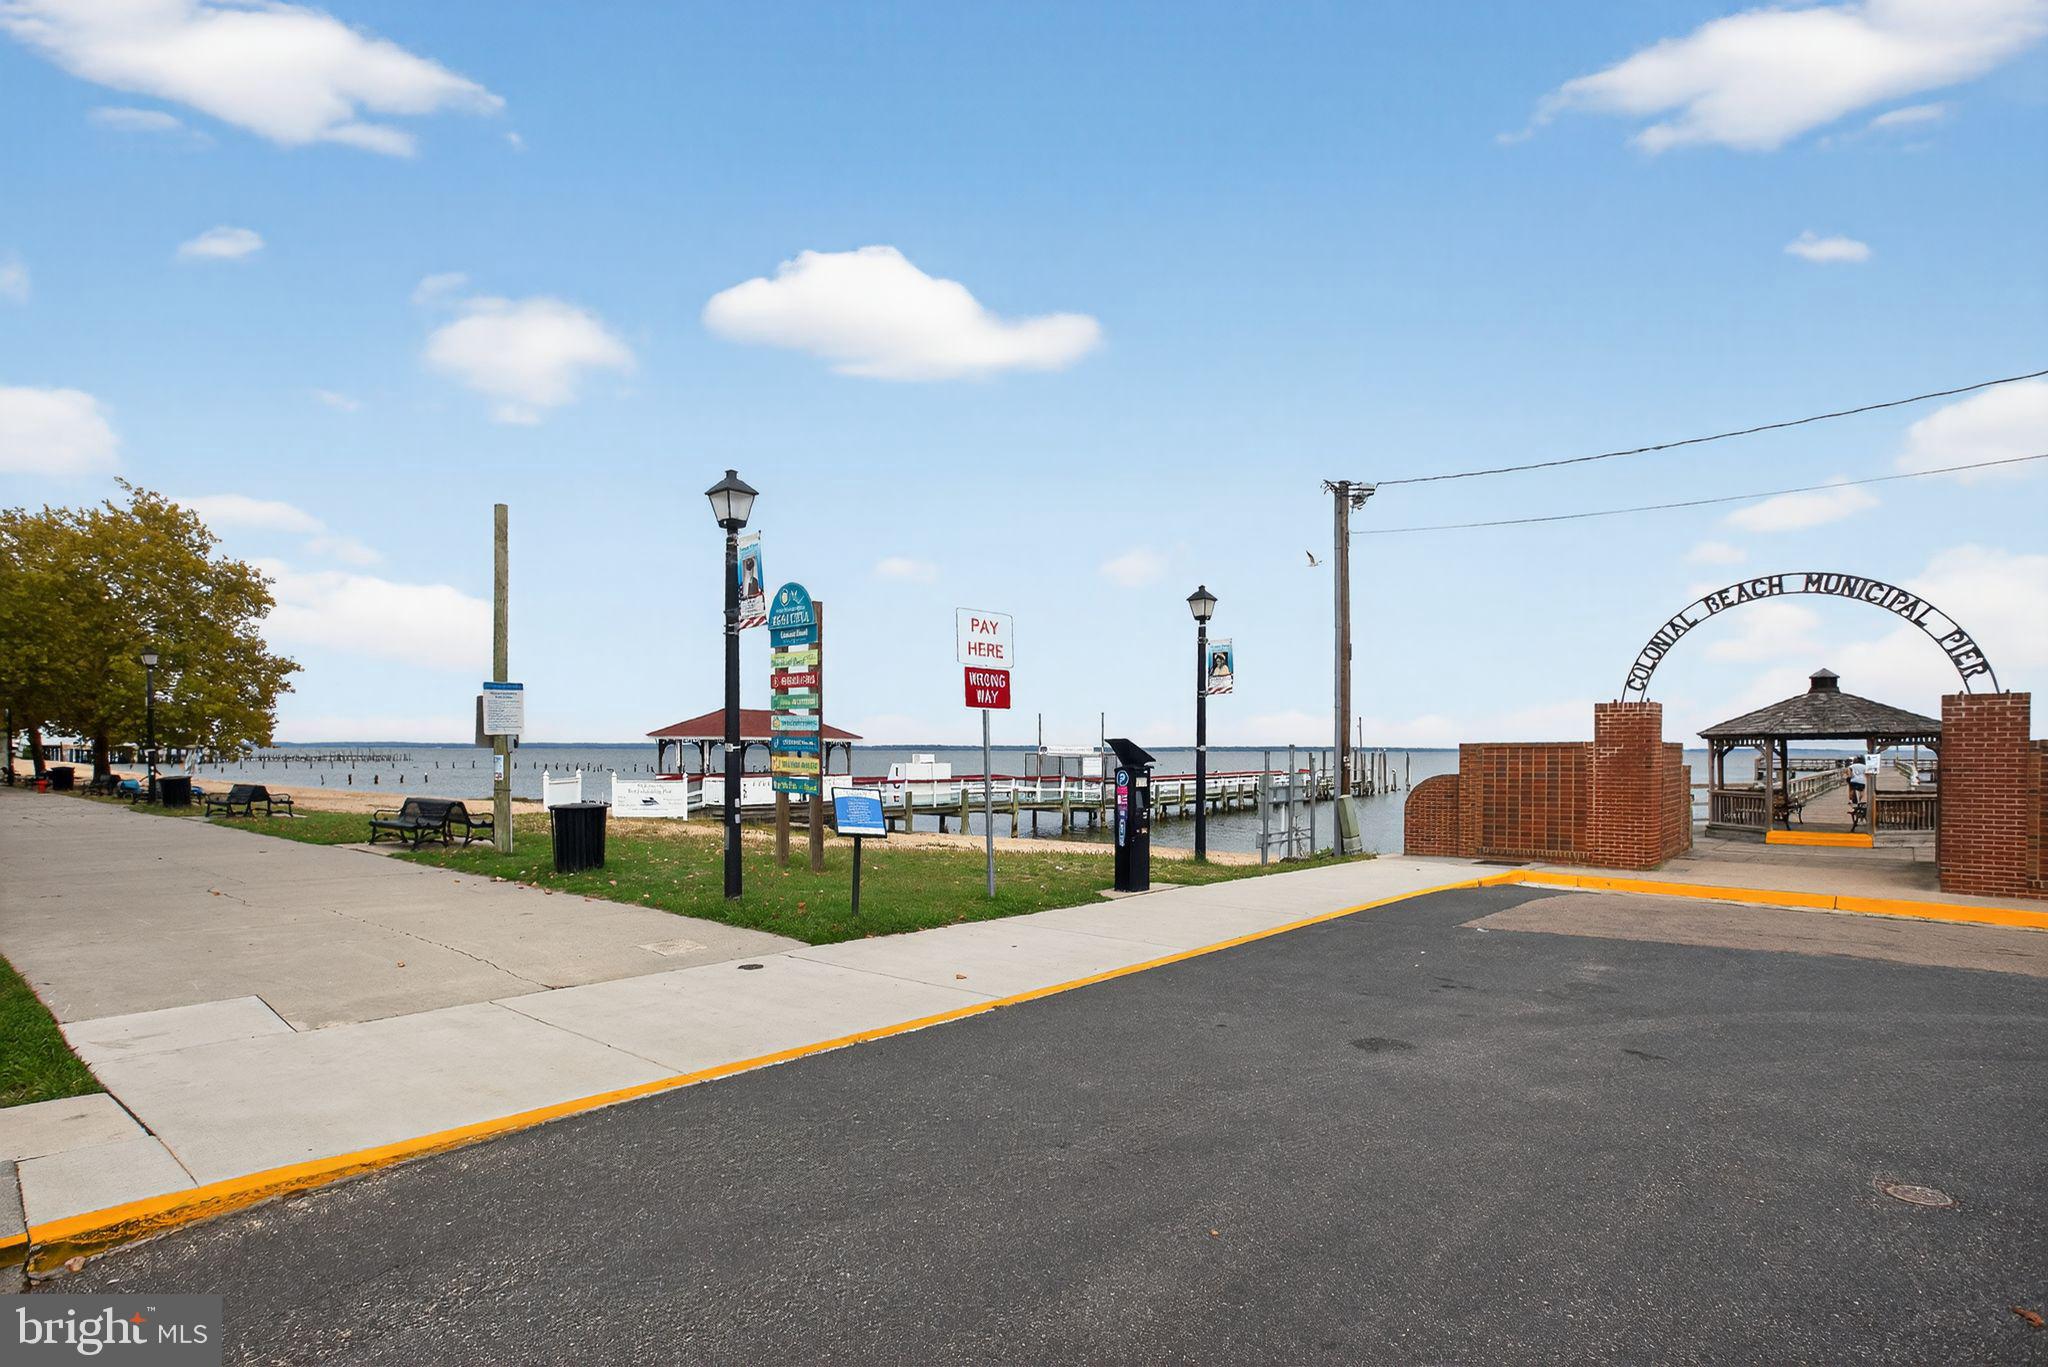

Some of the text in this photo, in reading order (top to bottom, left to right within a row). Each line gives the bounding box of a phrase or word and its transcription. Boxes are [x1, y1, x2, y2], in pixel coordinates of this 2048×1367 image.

[971, 617, 999, 635] PAY
[1627, 573, 1988, 691] COLONIAL BEACH MUNICIPAL PIER
[968, 641, 1003, 659] HERE
[969, 671, 1006, 688] WRONG
[976, 689, 999, 704] WAY
